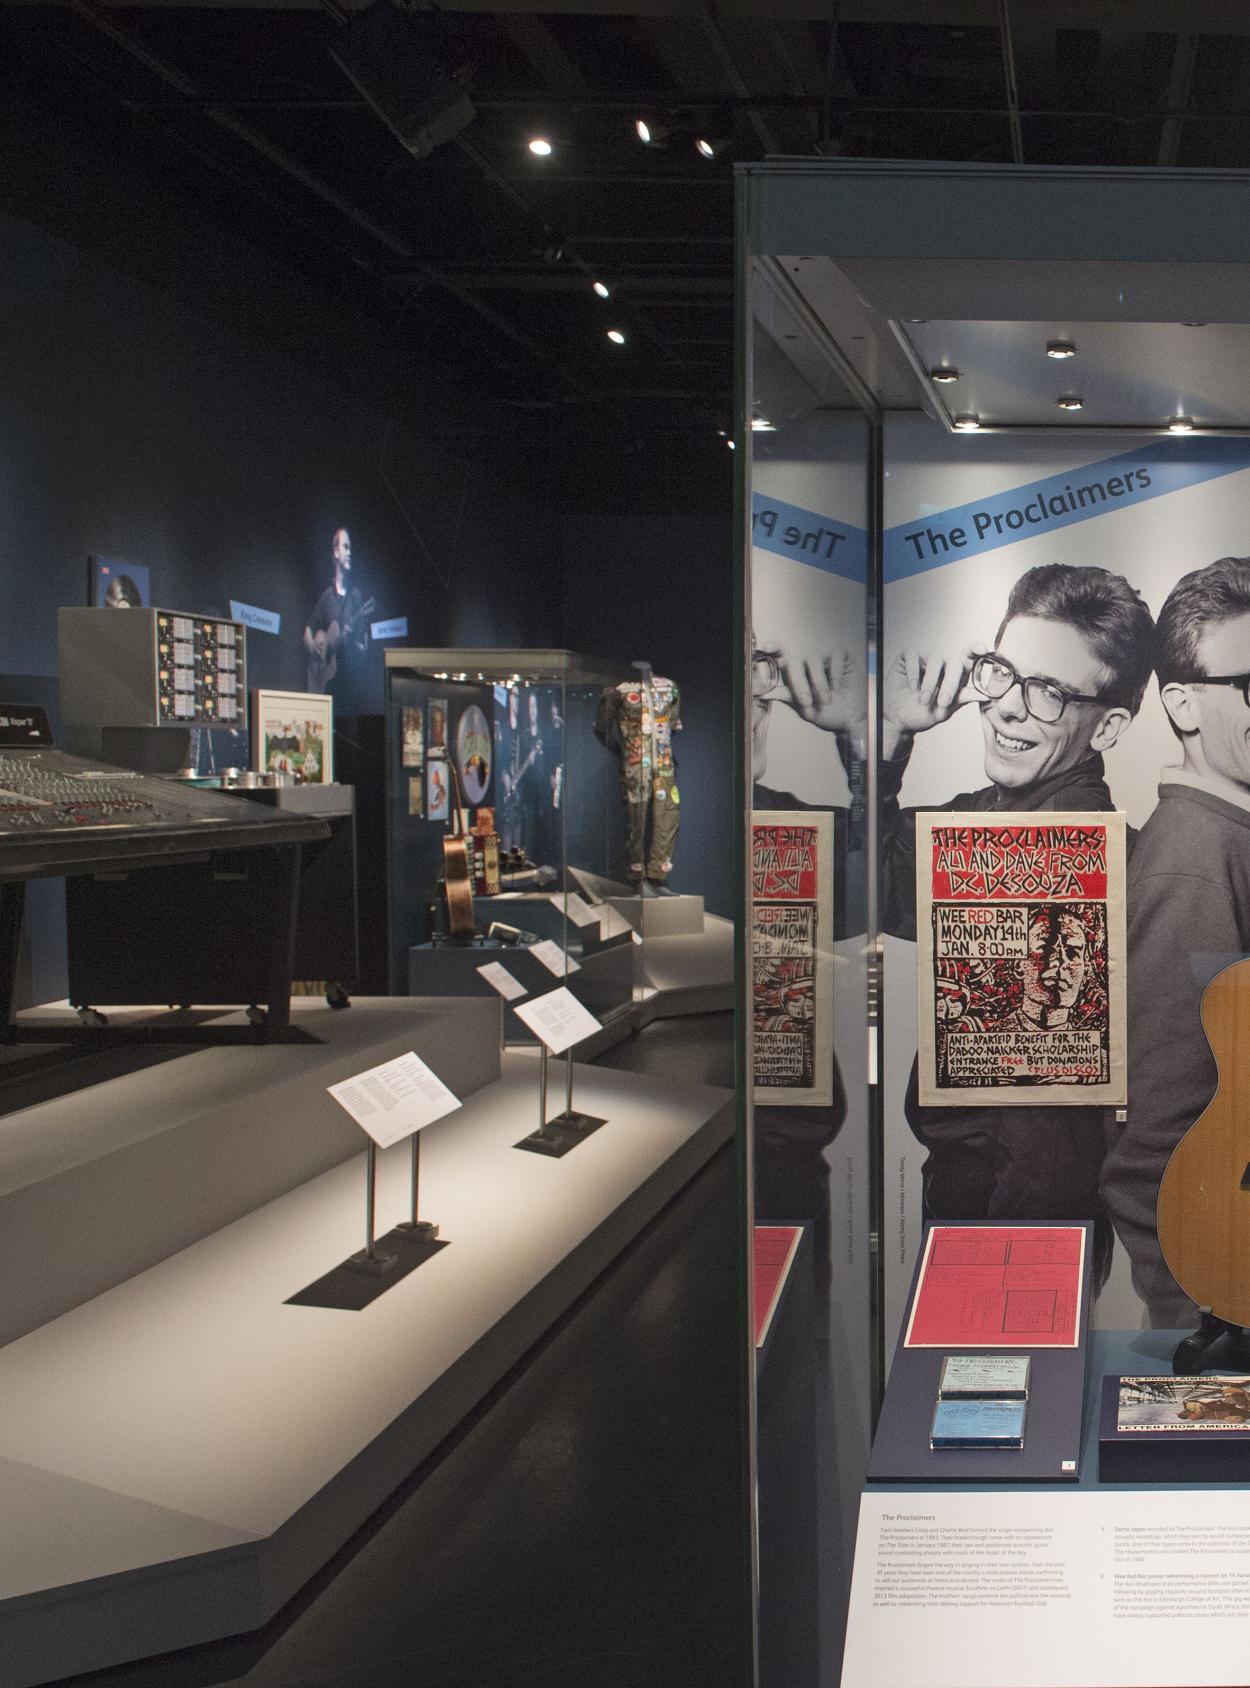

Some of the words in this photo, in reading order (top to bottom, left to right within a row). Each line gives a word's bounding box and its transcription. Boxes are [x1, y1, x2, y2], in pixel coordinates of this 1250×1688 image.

[904, 526, 968, 560] The
[972, 466, 1152, 540] Proclaimers
[932, 828, 968, 848] THE
[938, 850, 965, 871] ALI
[969, 850, 1000, 872] AND
[1005, 850, 1046, 872] DAVE
[1050, 852, 1106, 872] FROM
[985, 872, 1084, 898] DESOUZA
[939, 909, 966, 924] WEE
[968, 909, 994, 924] RED
[996, 909, 1024, 924] BAR
[941, 924, 999, 941] MONDAY
[1000, 924, 1026, 941] 14th
[941, 940, 974, 956] JAN.
[950, 1034, 1012, 1046] ANTI-APARTEID
[1014, 1034, 1049, 1045] BENEFIT
[1052, 1033, 1070, 1044] FOR
[1072, 1032, 1091, 1043] THE
[1032, 1044, 1099, 1056] SCHOLARSHIP
[949, 1056, 999, 1066] ENTRANCE
[1001, 1056, 1024, 1065] FREE
[1027, 1056, 1045, 1065] BUT
[1047, 1055, 1098, 1065] DONATIONS
[950, 1066, 1015, 1076] APPRECIATED
